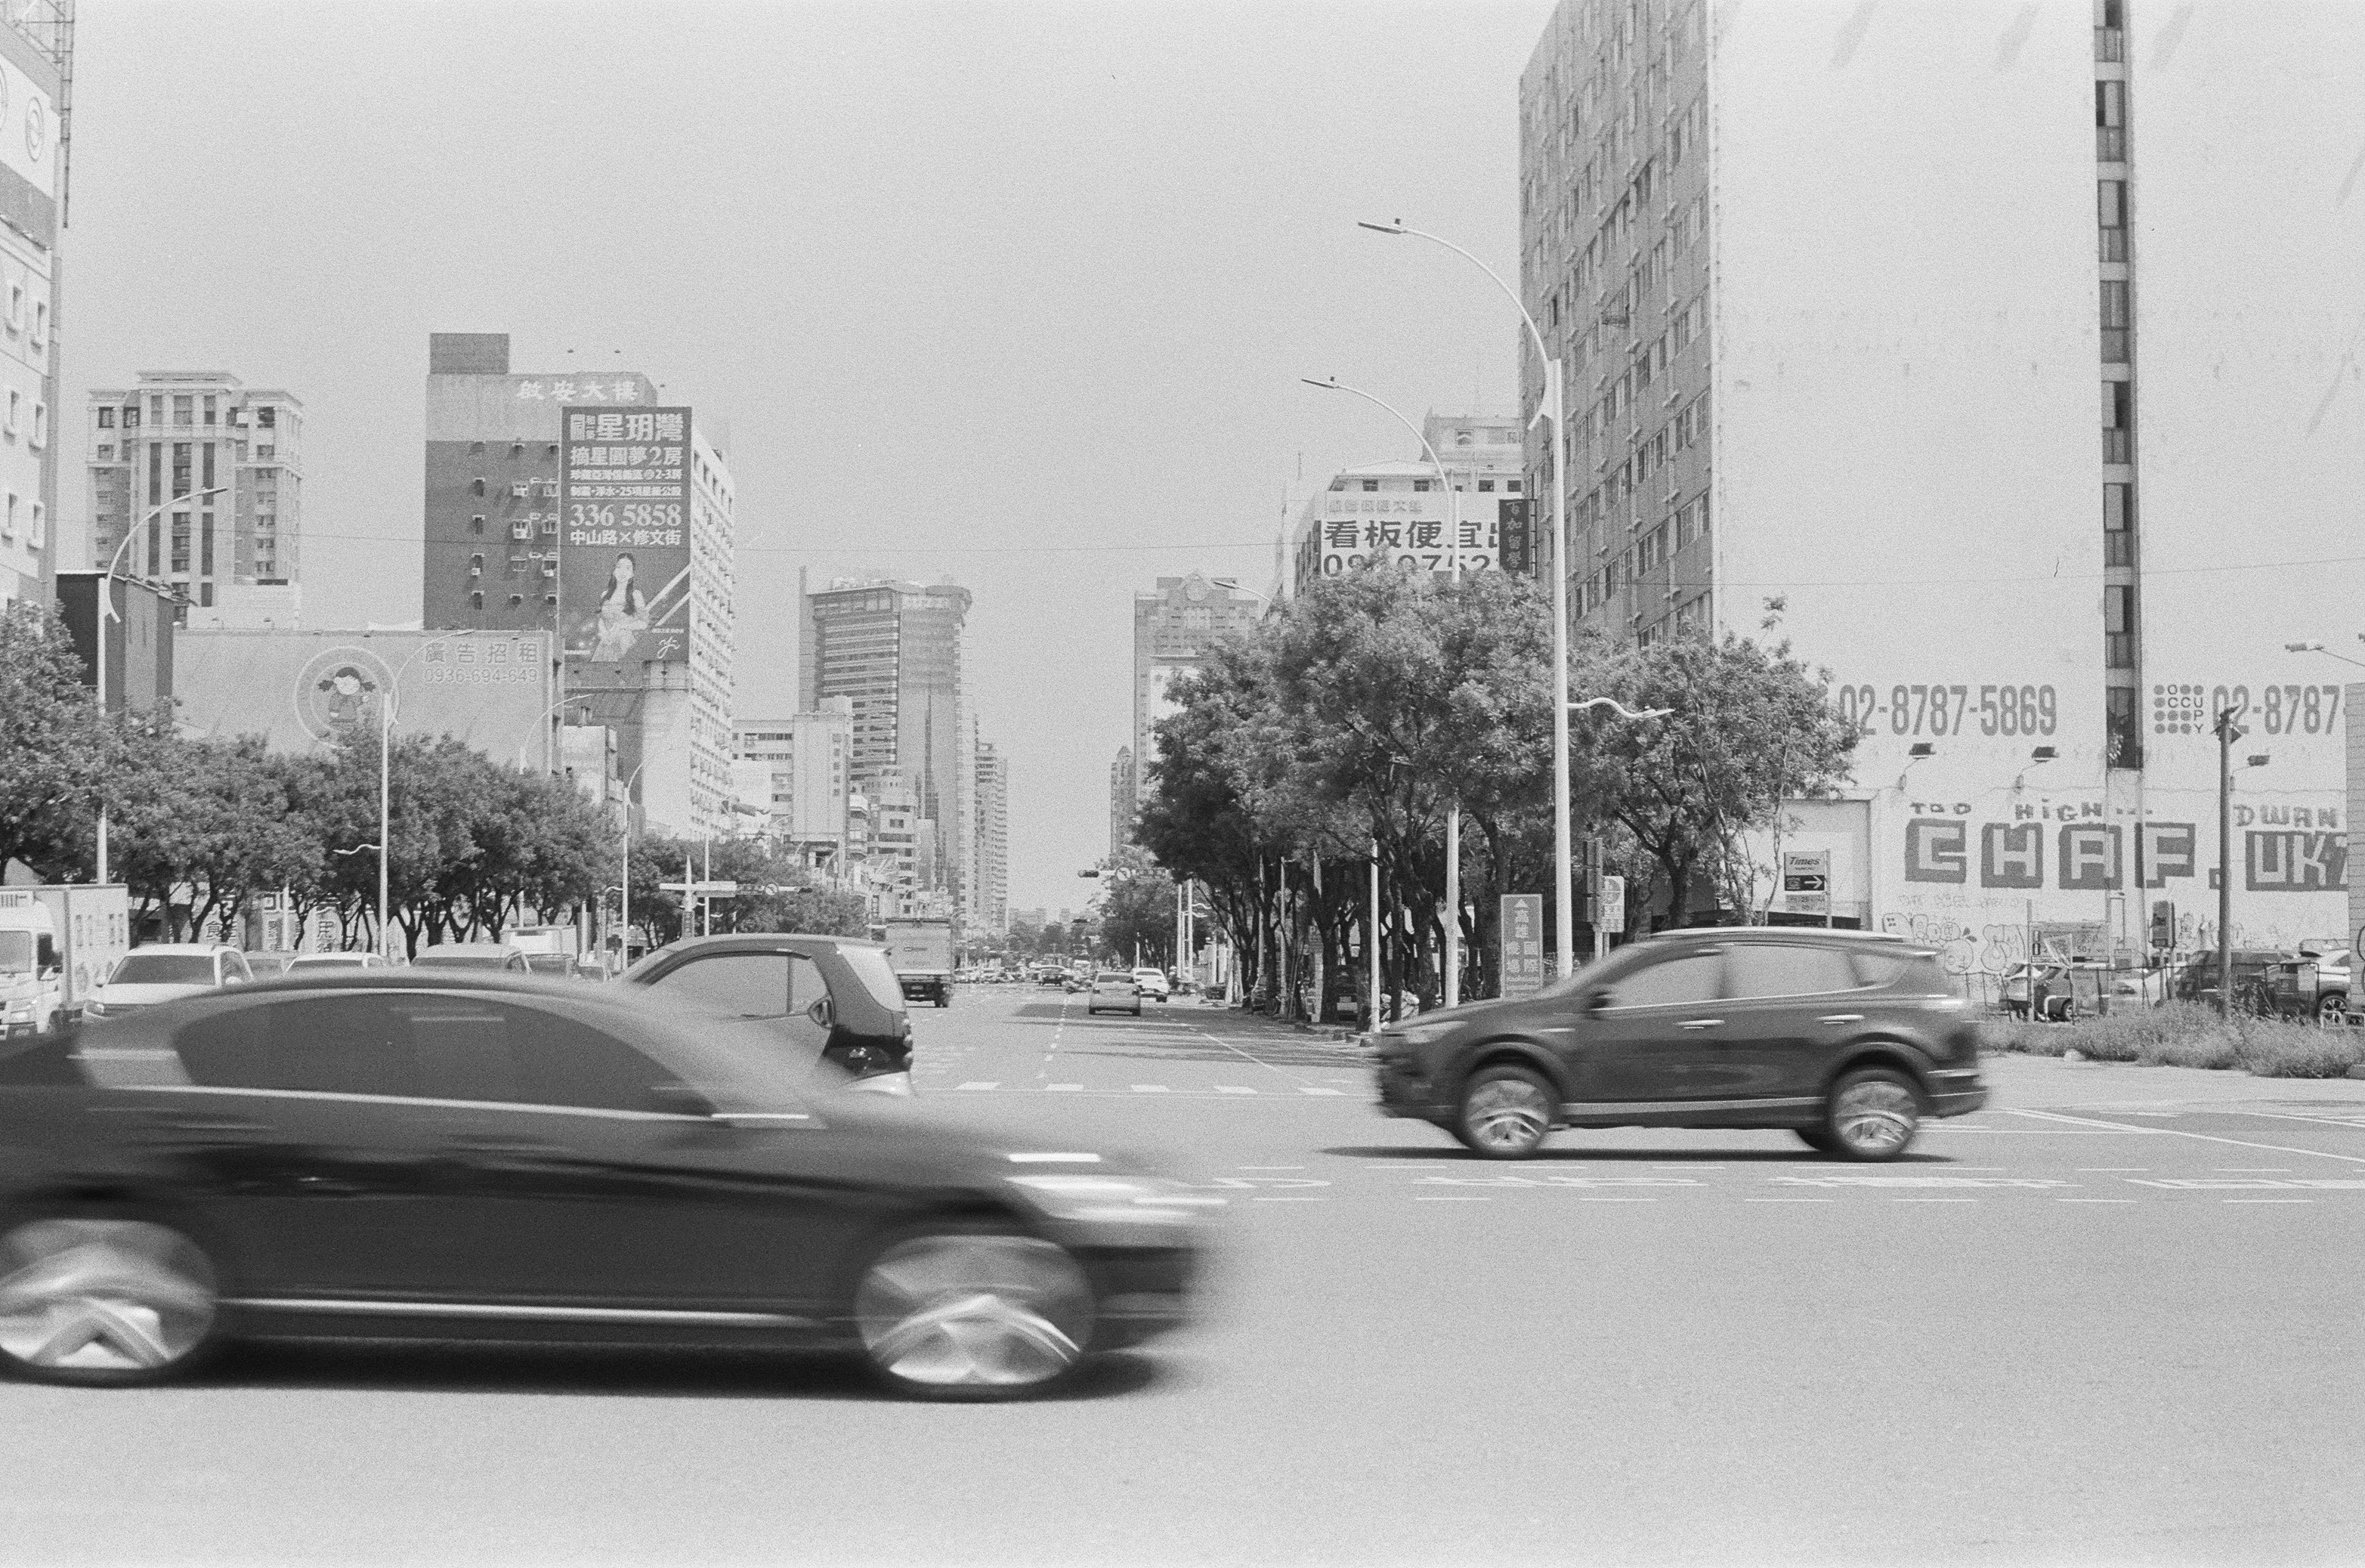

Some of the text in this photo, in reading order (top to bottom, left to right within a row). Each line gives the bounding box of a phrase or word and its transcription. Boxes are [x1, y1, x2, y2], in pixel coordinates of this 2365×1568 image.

[570, 503, 682, 527] 336 5858
[1838, 684, 2057, 737] 02-8787-5869
[2212, 684, 2345, 735] 02-8787
